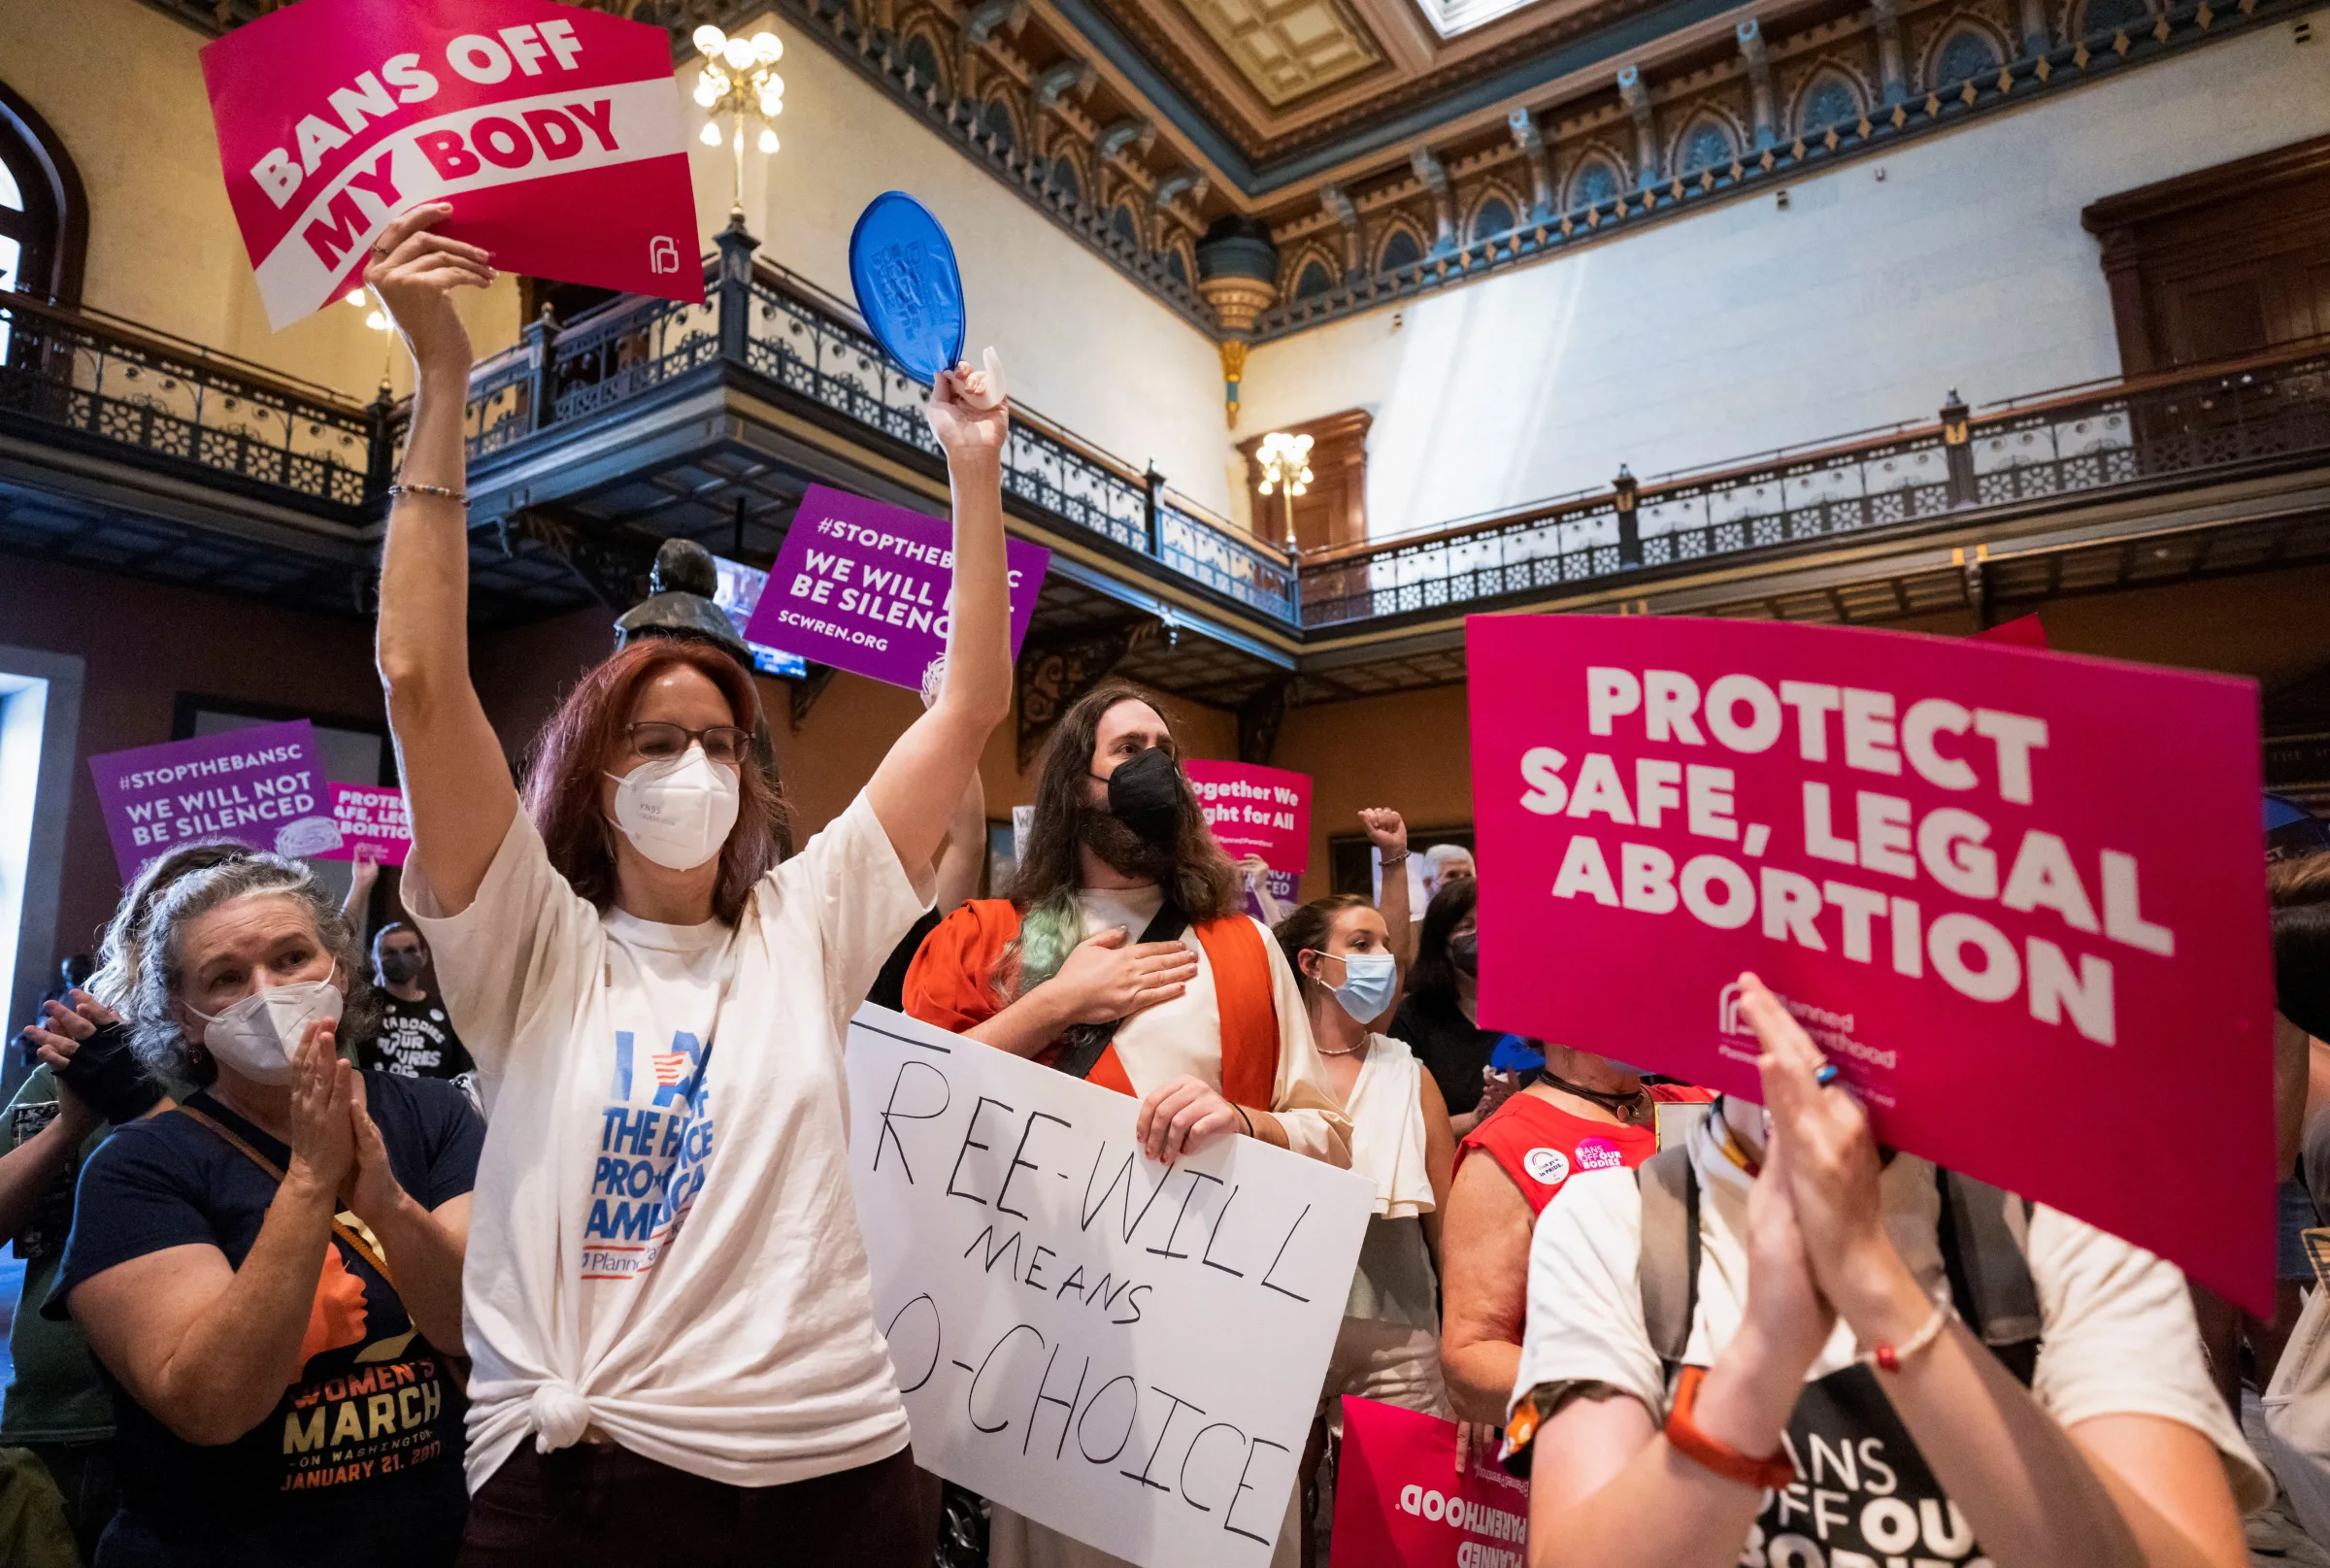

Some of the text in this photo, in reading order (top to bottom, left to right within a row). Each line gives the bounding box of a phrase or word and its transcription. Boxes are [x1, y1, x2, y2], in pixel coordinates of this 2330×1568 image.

[250, 18, 583, 210] BANS OFF
[302, 99, 618, 273] MY BODY
[805, 549, 854, 583] WE
[862, 564, 933, 606] WILL
[817, 517, 1022, 587] #STOPTHEBC
[778, 609, 888, 651] SCWREN.ORG
[789, 573, 835, 604] BE
[838, 587, 950, 640] SILENC
[119, 743, 304, 791] #STOPTHEBANSC
[1586, 666, 2048, 806] PROTECT
[125, 771, 312, 824] WE WILL NOT
[131, 793, 315, 847] BE SILENCED
[333, 805, 372, 822] AFE,
[1191, 780, 1299, 807] ogether We
[1202, 803, 1294, 830] ght for All
[1519, 747, 2175, 956] SAFE, LEGAL
[1551, 836, 2116, 1047] ABORTION
[602, 1106, 661, 1156] THE
[850, 1020, 1311, 1303] REE-WILL
[1582, 1158, 1621, 1169] BODIES
[1599, 1151, 1622, 1160] OUR
[964, 1225, 1153, 1325] MEANS
[283, 1379, 441, 1454] MARCH
[884, 1292, 1291, 1547] O-CHOICE
[280, 1459, 376, 1491] JANUARY
[1781, 1428, 1897, 1495] NS
[1758, 1482, 1850, 1541] FF
[1859, 1496, 1975, 1559] OU
